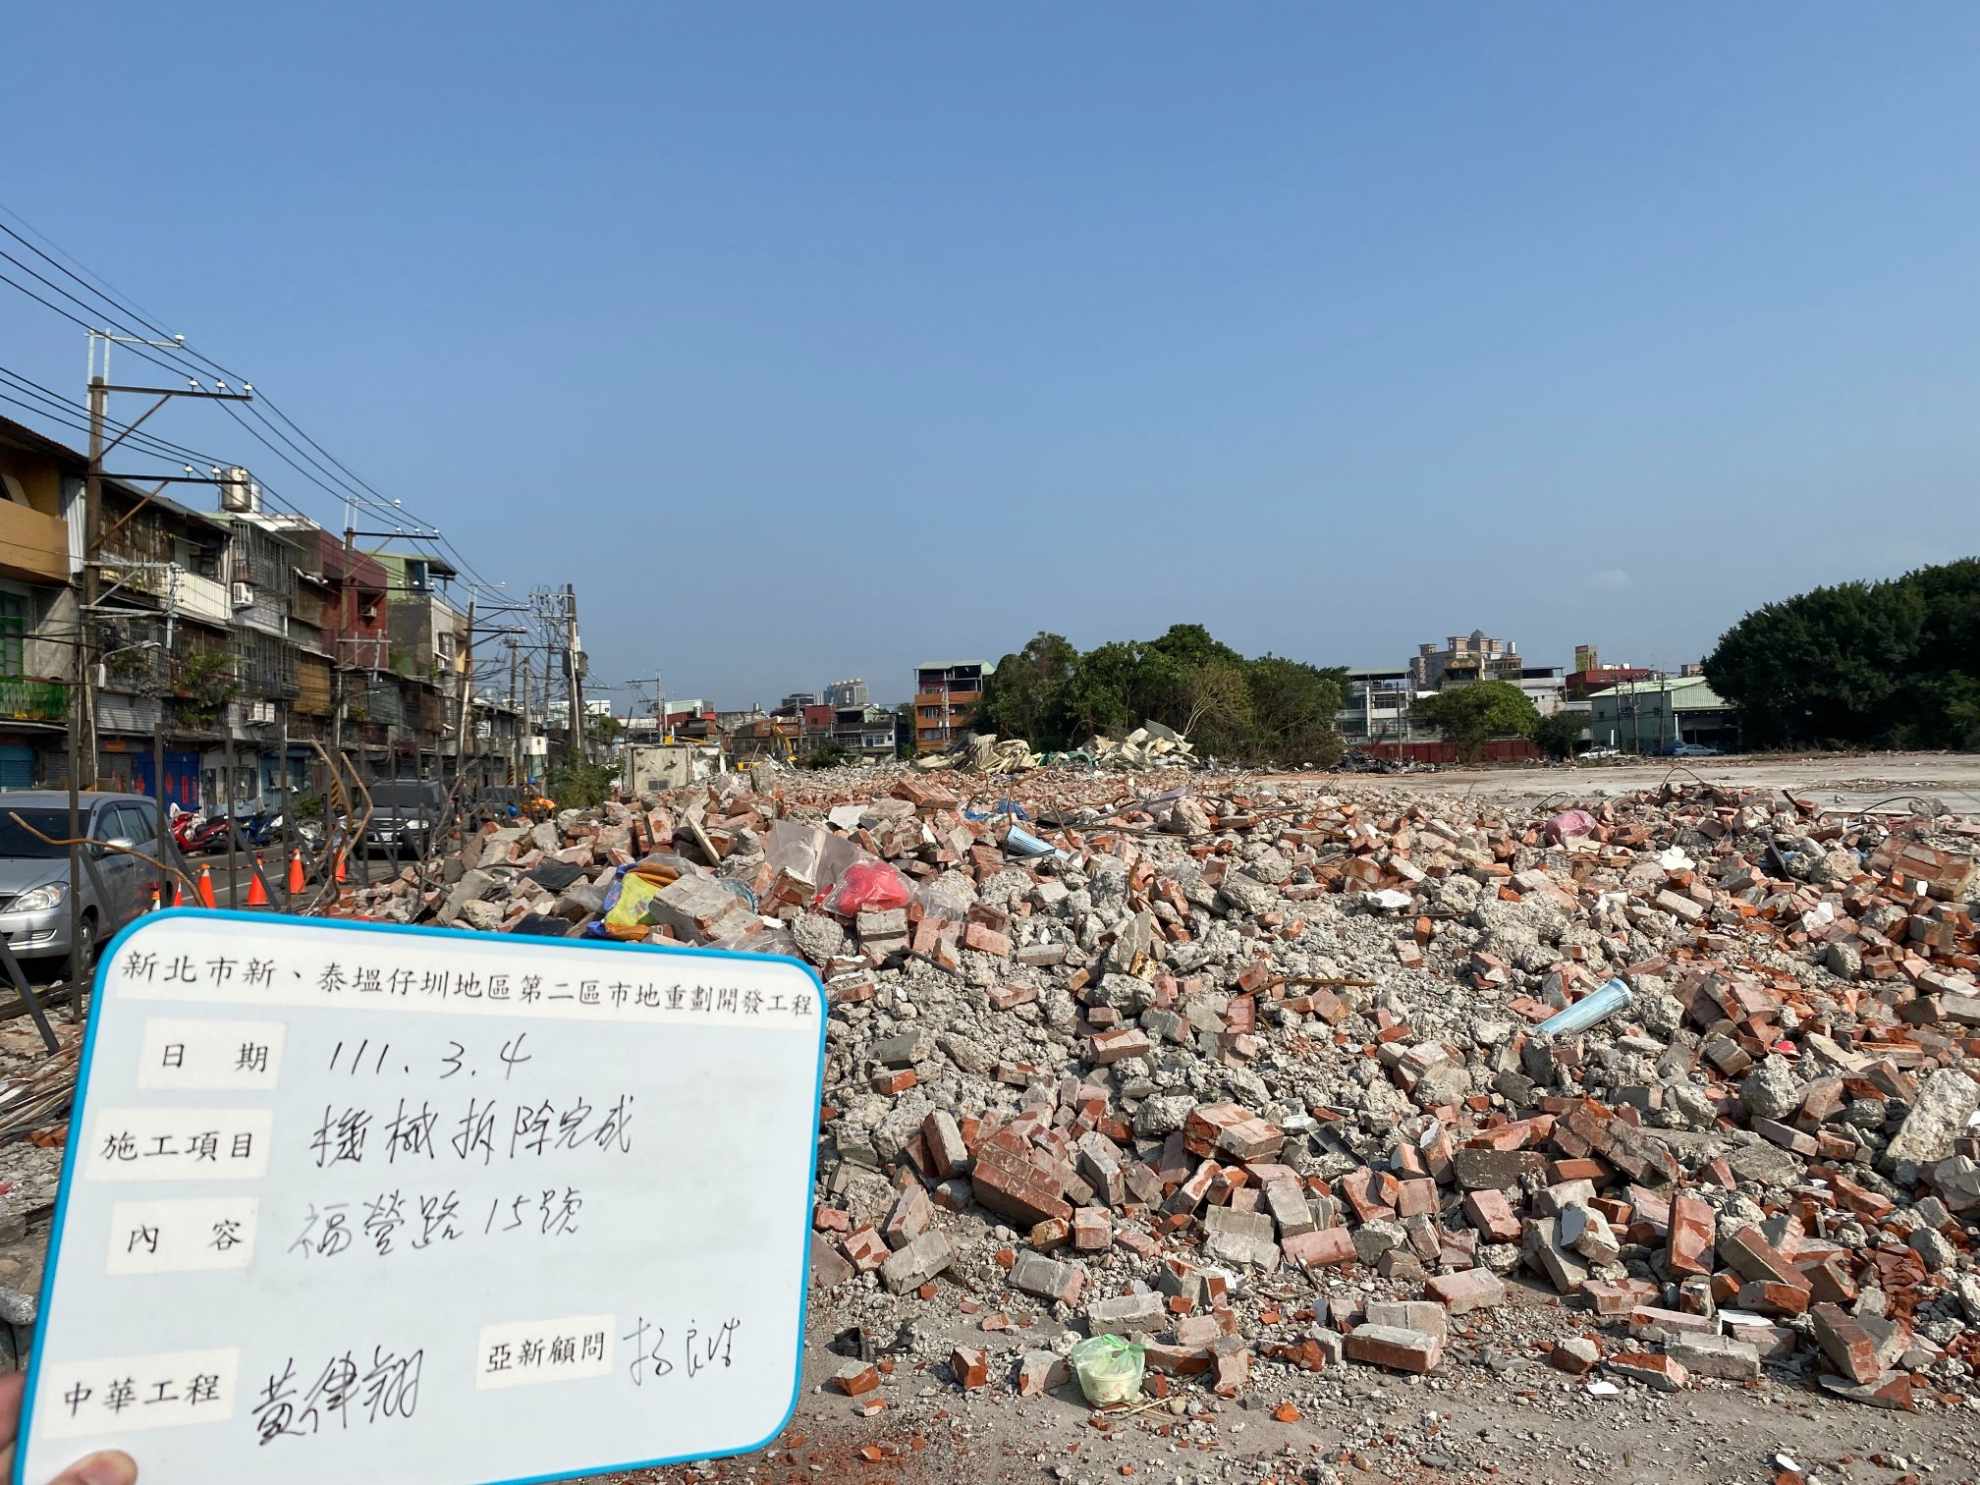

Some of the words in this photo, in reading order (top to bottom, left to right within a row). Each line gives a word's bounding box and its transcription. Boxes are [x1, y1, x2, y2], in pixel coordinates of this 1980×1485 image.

[162, 1042, 269, 1073] 日期
[99, 1131, 253, 1163] 施工項目
[309, 1094, 635, 1168] 機械拆除完成
[485, 1331, 605, 1373] 亞新顧問
[64, 1374, 221, 1418] 中華工程
